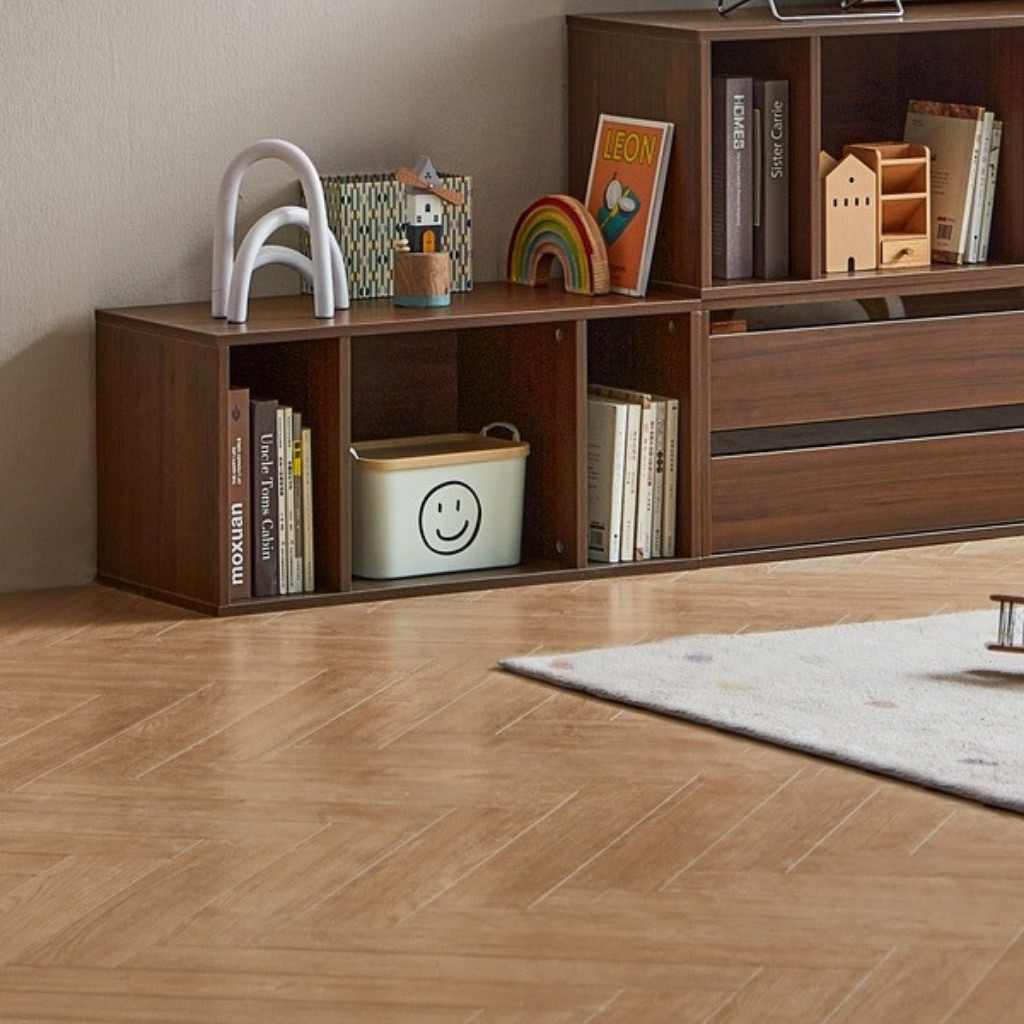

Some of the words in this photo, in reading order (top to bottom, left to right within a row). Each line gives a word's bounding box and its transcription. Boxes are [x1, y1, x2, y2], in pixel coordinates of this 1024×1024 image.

[733, 95, 745, 150] HOMES
[771, 100, 784, 140] Carrie
[603, 129, 656, 164] LEON
[771, 142, 783, 179] Sister
[260, 433, 273, 474] Uncle
[231, 503, 243, 585] moxuan
[261, 518, 274, 561] Cabin
